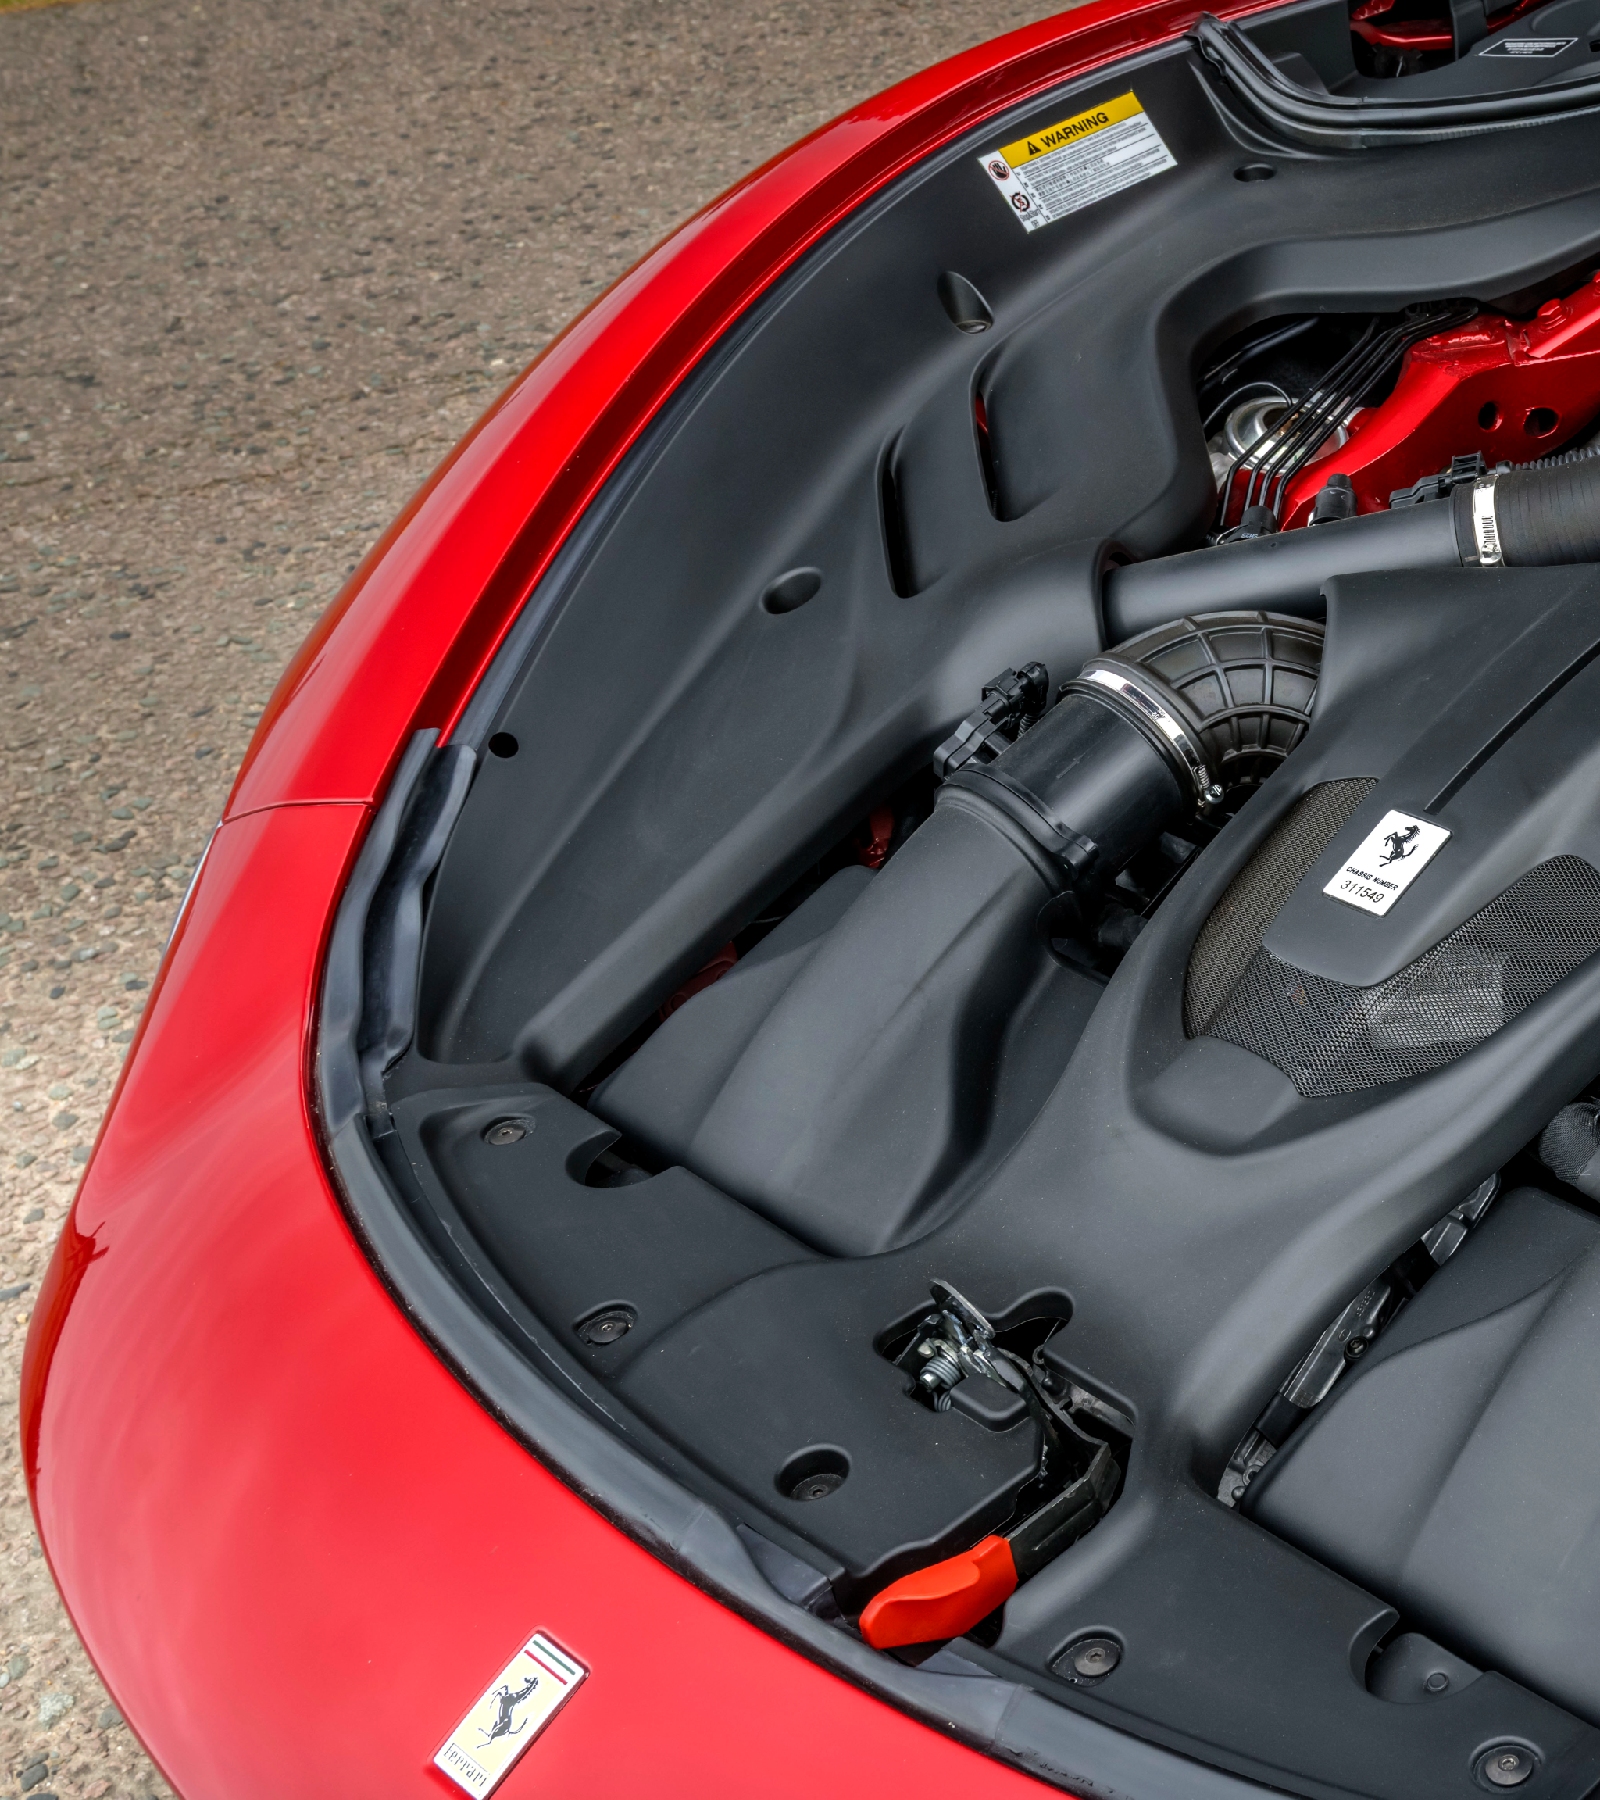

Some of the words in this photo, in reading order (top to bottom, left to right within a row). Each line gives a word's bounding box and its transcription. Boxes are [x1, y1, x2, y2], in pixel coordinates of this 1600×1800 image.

[1040, 112, 1110, 148] WARNING
[1340, 880, 1385, 904] 311549
[1346, 866, 1373, 881] CHASSIS
[1372, 876, 1399, 891] NUMBER
[443, 1742, 489, 1787] Ferrari
